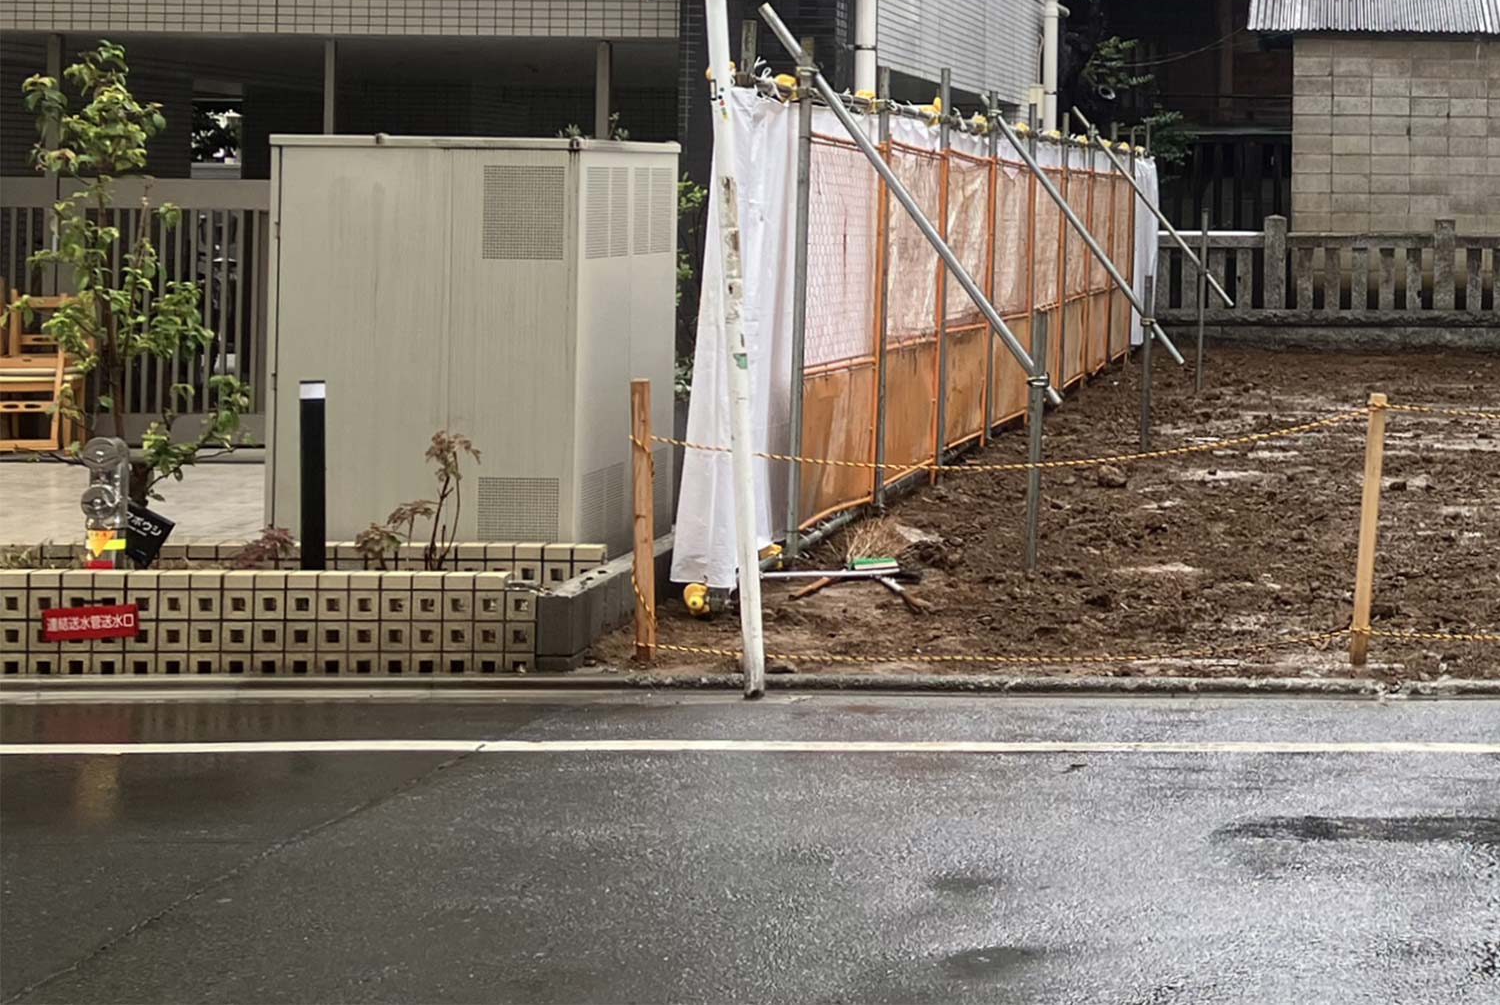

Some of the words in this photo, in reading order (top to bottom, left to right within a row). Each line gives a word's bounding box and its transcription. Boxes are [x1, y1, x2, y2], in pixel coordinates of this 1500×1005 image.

[46, 613, 134, 632] 連結送水管送水口
